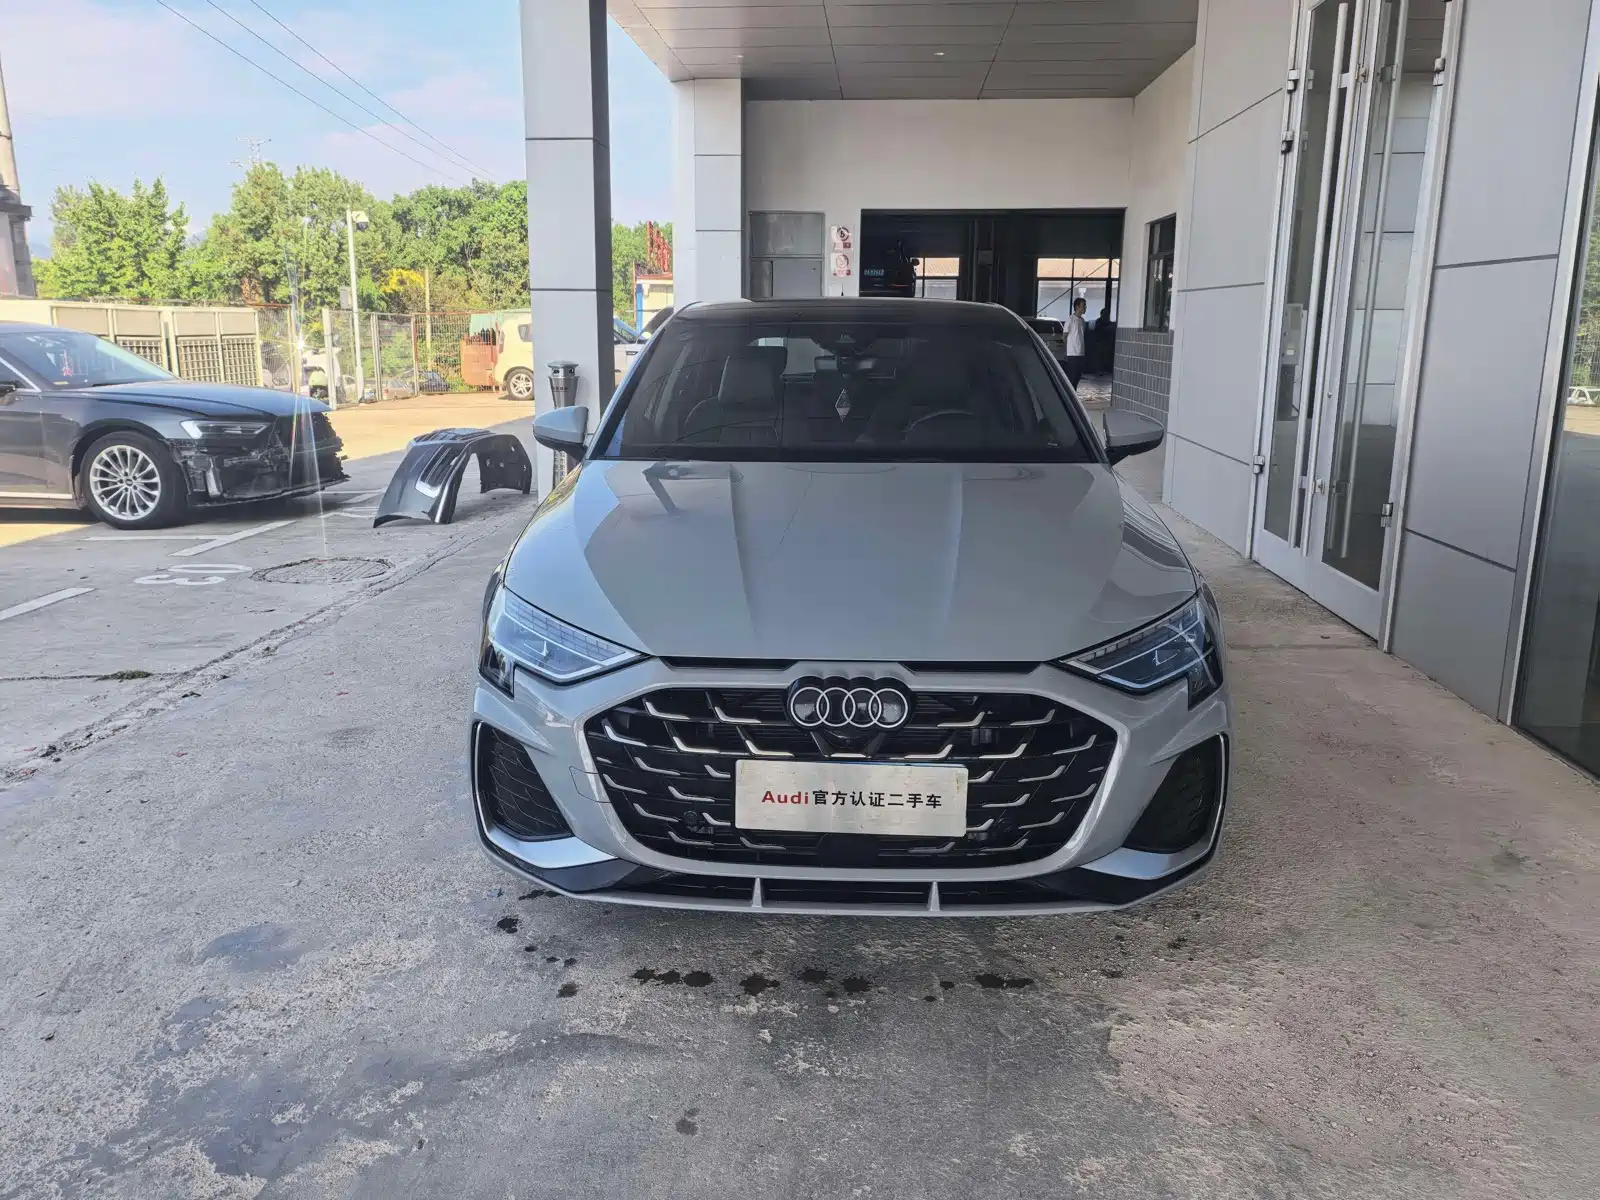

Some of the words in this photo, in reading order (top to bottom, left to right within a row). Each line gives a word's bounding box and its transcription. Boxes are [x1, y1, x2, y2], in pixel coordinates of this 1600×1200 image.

[761, 790, 809, 805] Audi
[812, 790, 942, 809] 官方认证二手车
